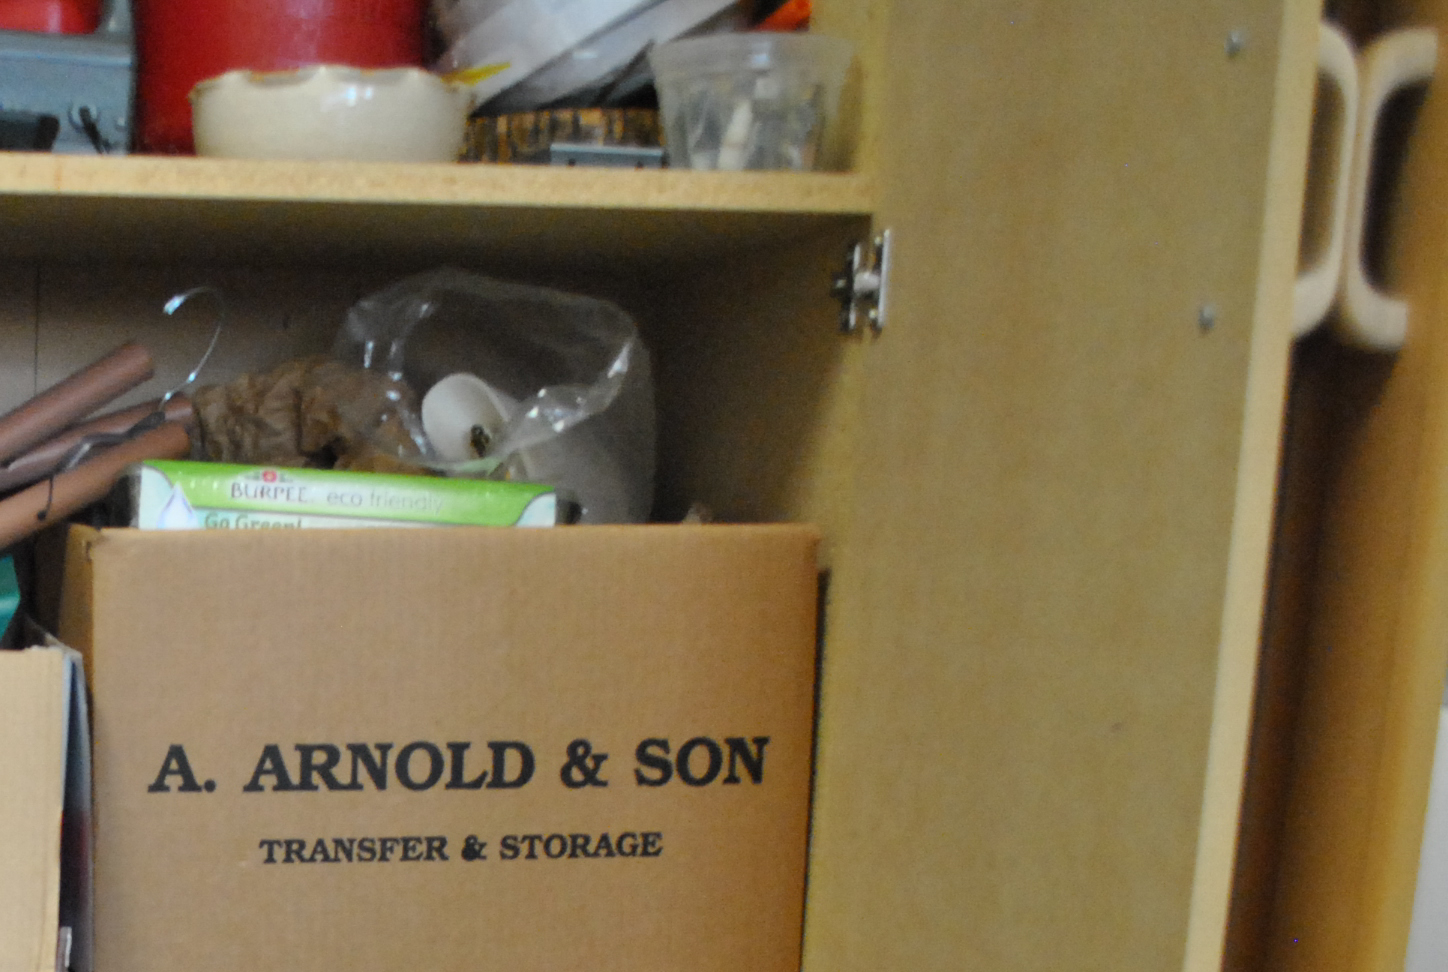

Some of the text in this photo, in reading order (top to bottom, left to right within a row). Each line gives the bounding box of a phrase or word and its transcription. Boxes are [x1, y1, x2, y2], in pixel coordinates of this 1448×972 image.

[230, 482, 444, 515] BURPEE eco friendly
[147, 735, 771, 793] A. ARNOLD & SON
[258, 831, 664, 864] TRANSFER & STORAGE
